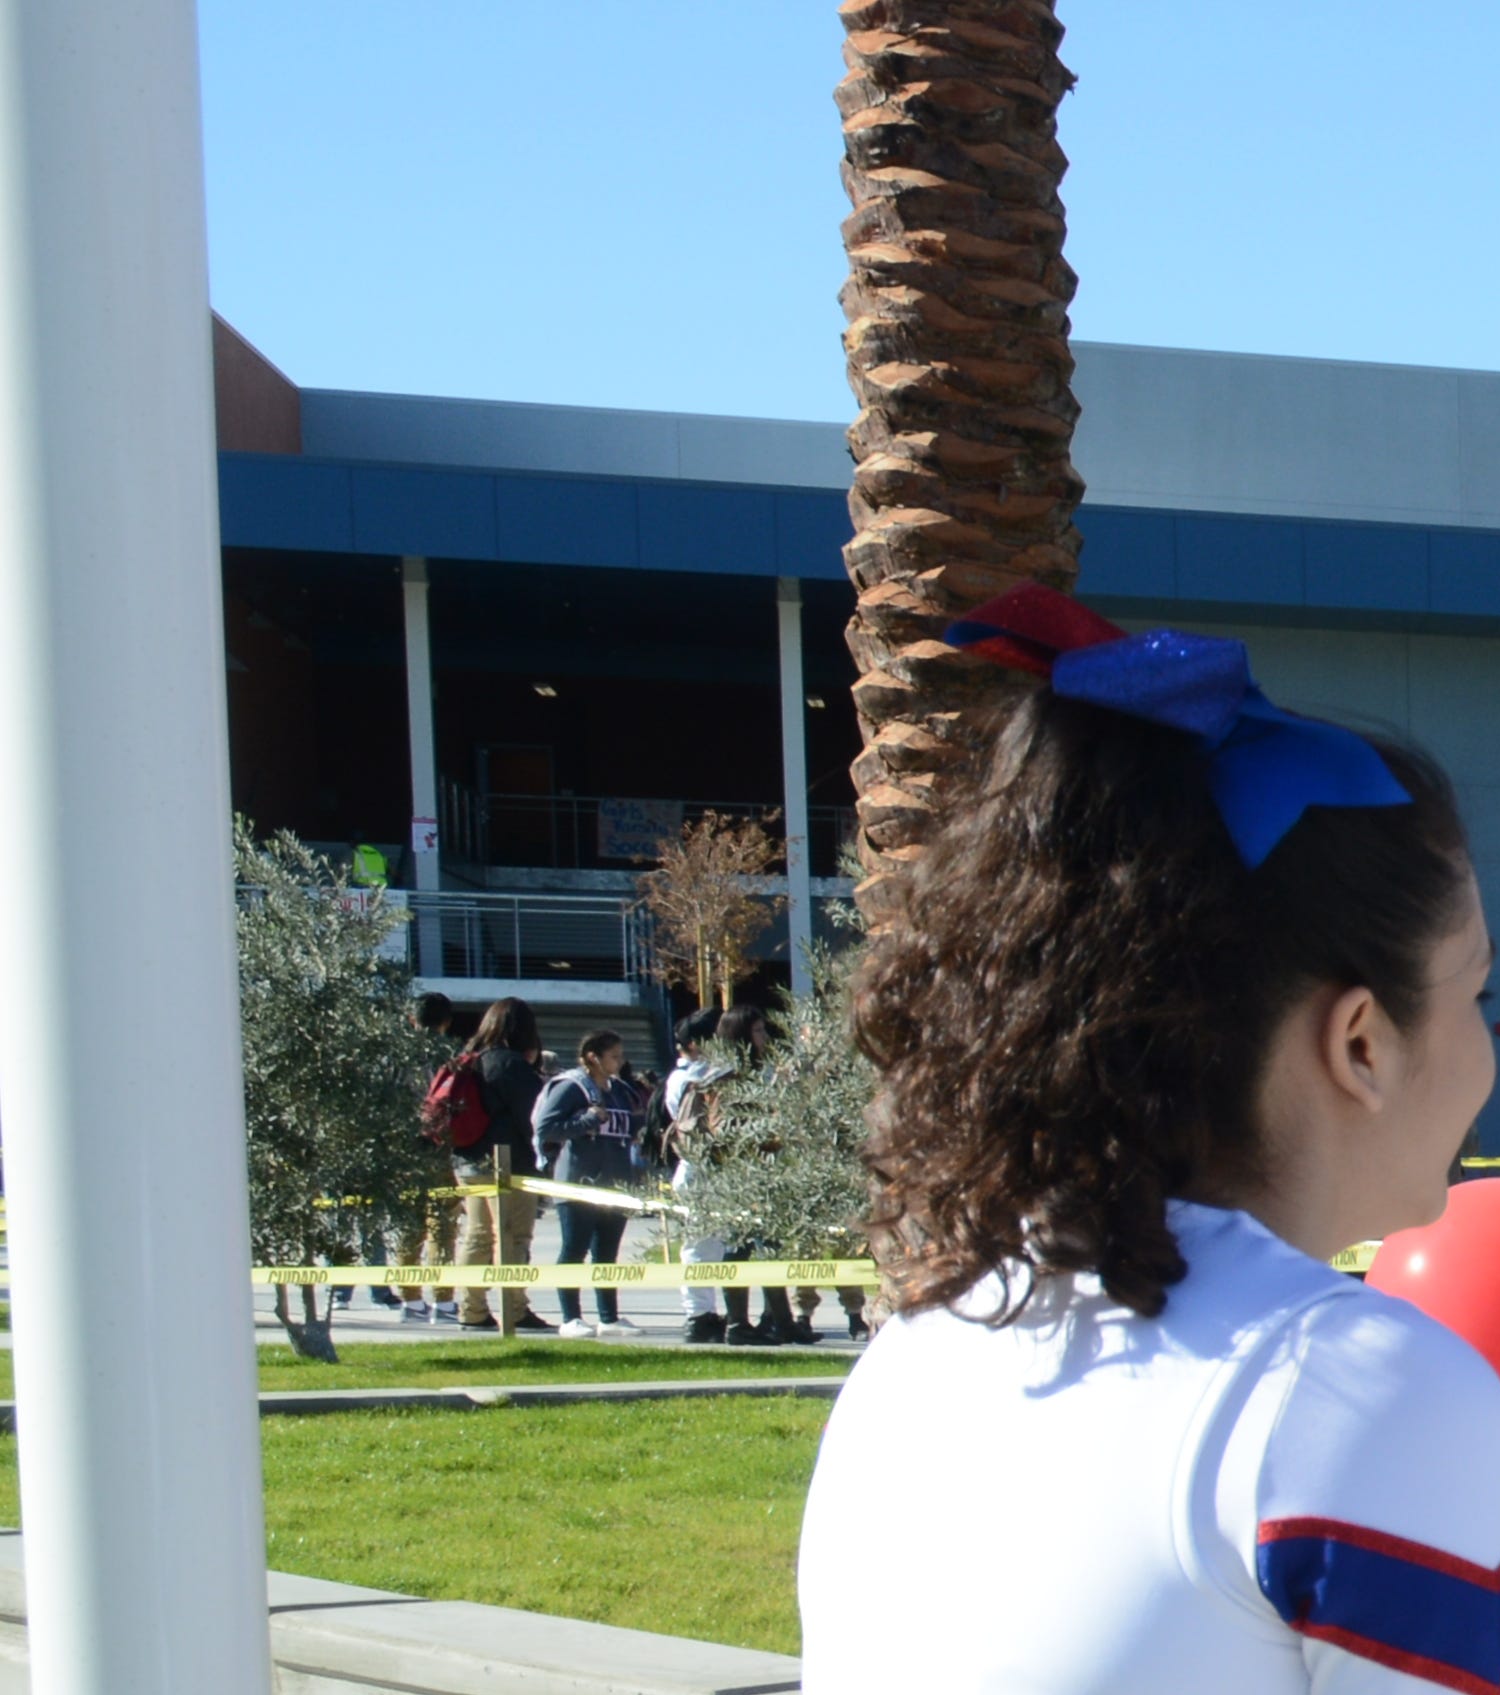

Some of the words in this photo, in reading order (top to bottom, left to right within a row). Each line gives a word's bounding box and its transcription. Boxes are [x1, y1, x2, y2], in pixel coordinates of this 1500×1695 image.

[384, 1269, 441, 1283] CAUTION
[483, 1268, 539, 1282] CUIDADO
[592, 1266, 645, 1281] CAUTION
[684, 1264, 737, 1280] CUIDADO
[786, 1262, 838, 1279] CAUTION
